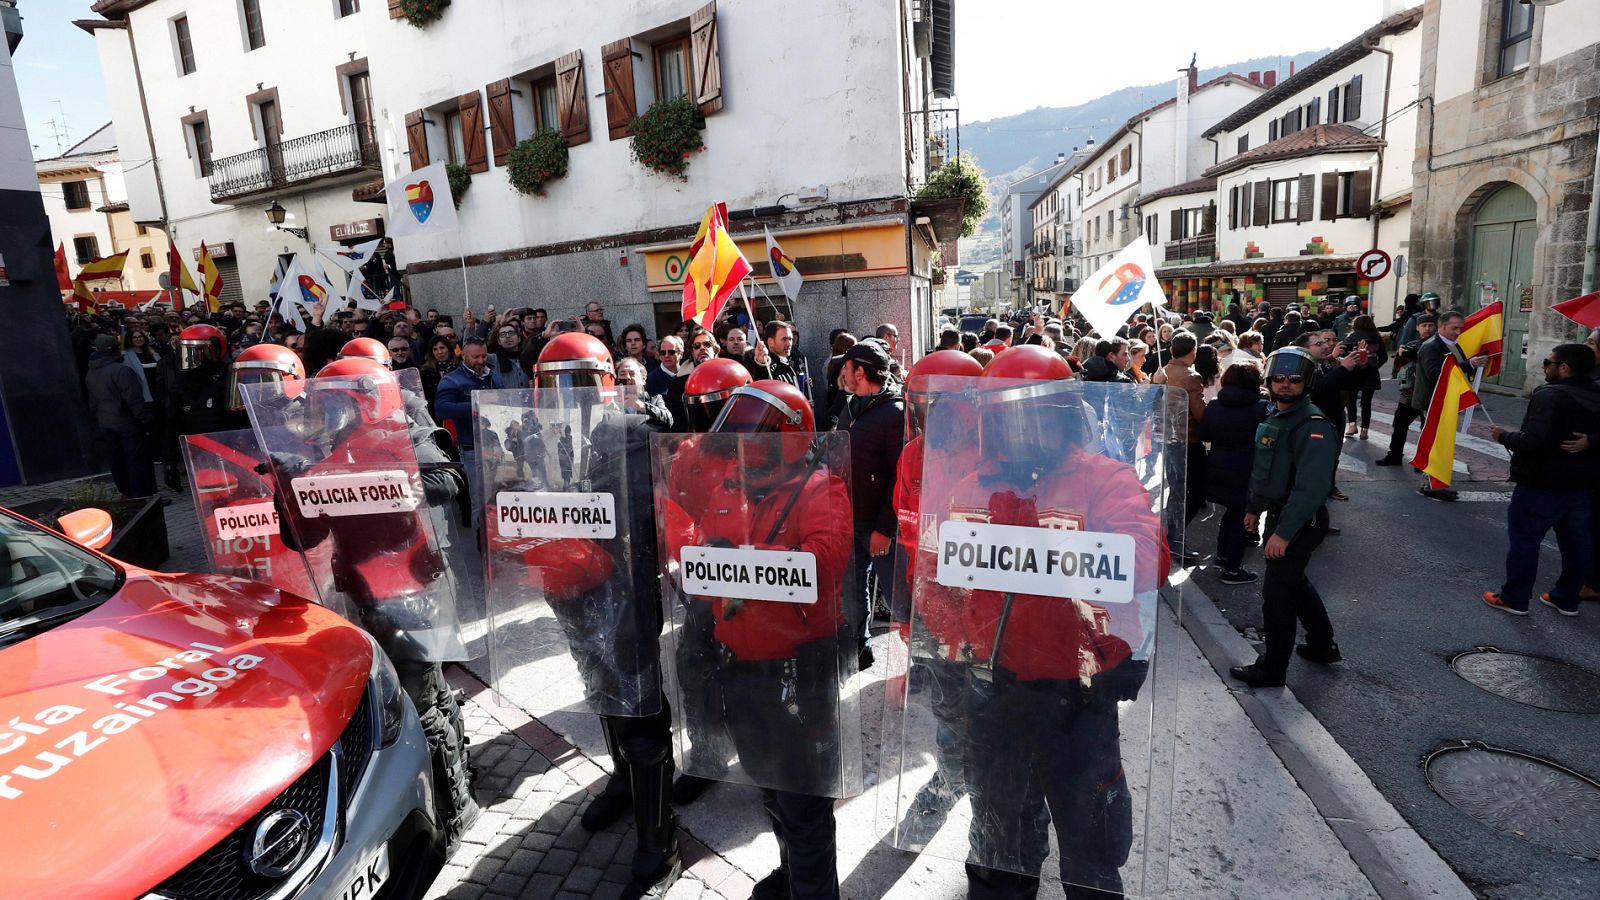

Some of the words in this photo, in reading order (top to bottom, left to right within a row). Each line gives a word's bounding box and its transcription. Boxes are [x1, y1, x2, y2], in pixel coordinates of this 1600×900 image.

[335, 223, 370, 237] ELIZALDE
[298, 487, 358, 506] POLICIA
[359, 483, 408, 502] FORAL
[219, 513, 270, 531] POLICIA
[501, 506, 558, 524] POLICIA
[561, 507, 612, 525] FORAL
[943, 541, 1039, 574] POLICIA
[1046, 549, 1128, 582] FORAL
[685, 561, 751, 584] POLICIA
[755, 566, 812, 588] FORAL
[84, 641, 225, 696] Foral
